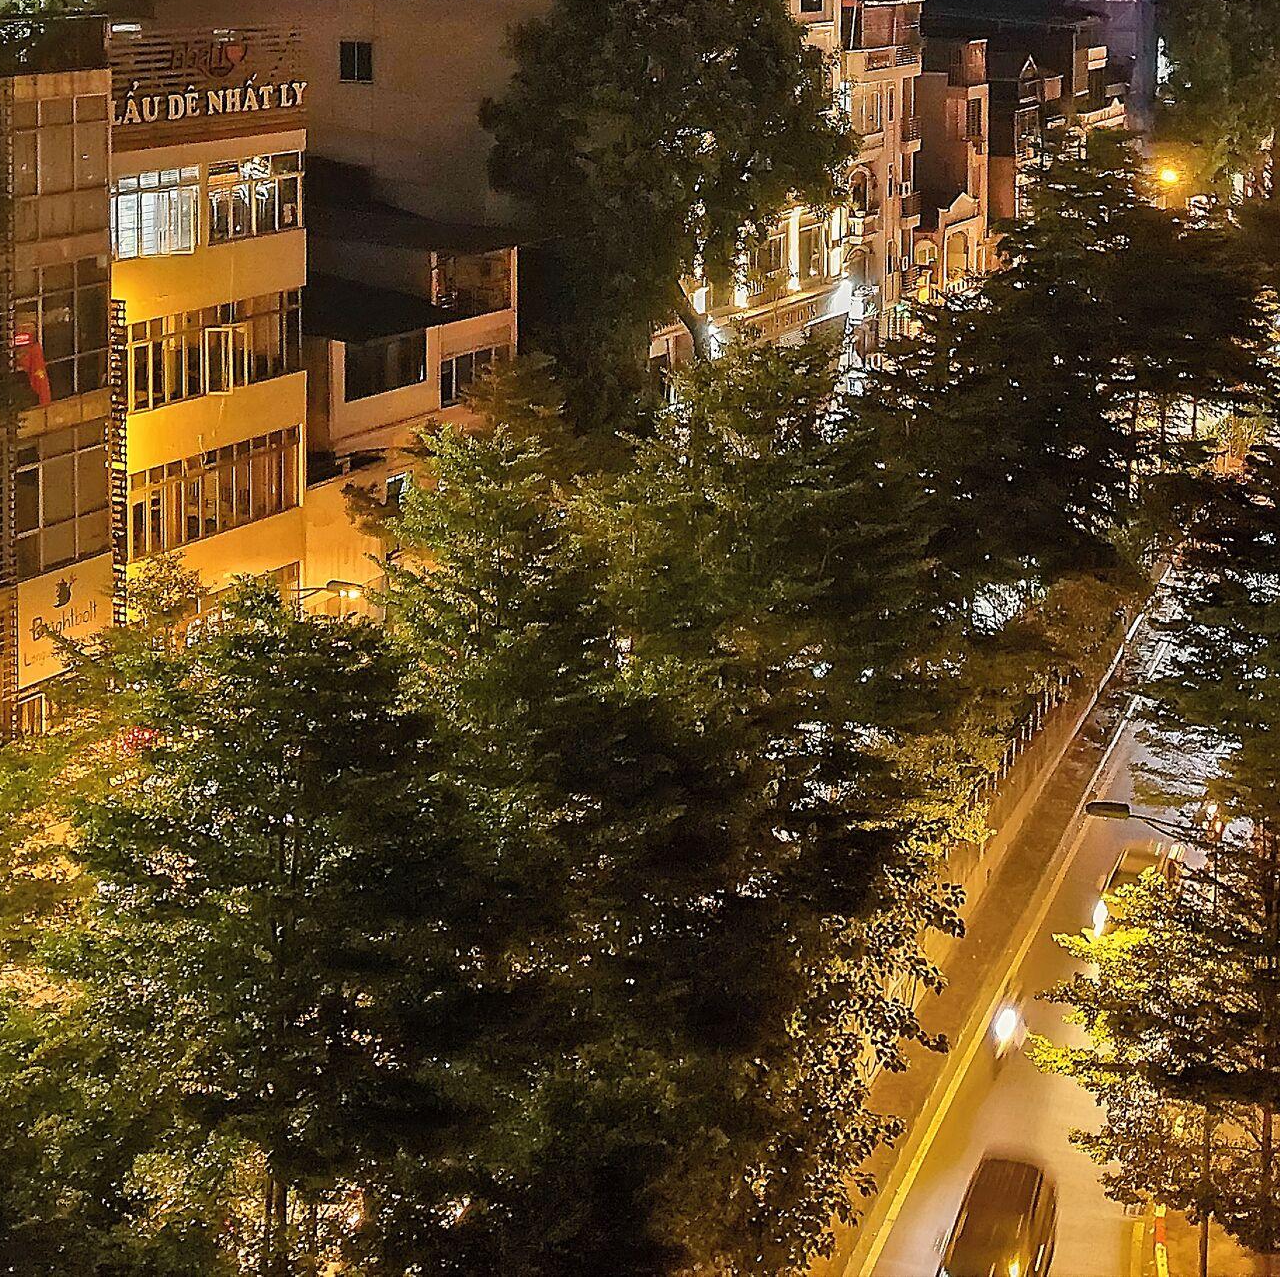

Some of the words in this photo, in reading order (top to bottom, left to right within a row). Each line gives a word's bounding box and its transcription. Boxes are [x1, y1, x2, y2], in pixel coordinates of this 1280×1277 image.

[167, 84, 200, 120] DÊ
[207, 73, 273, 115] NHẤT
[280, 82, 308, 107] LY
